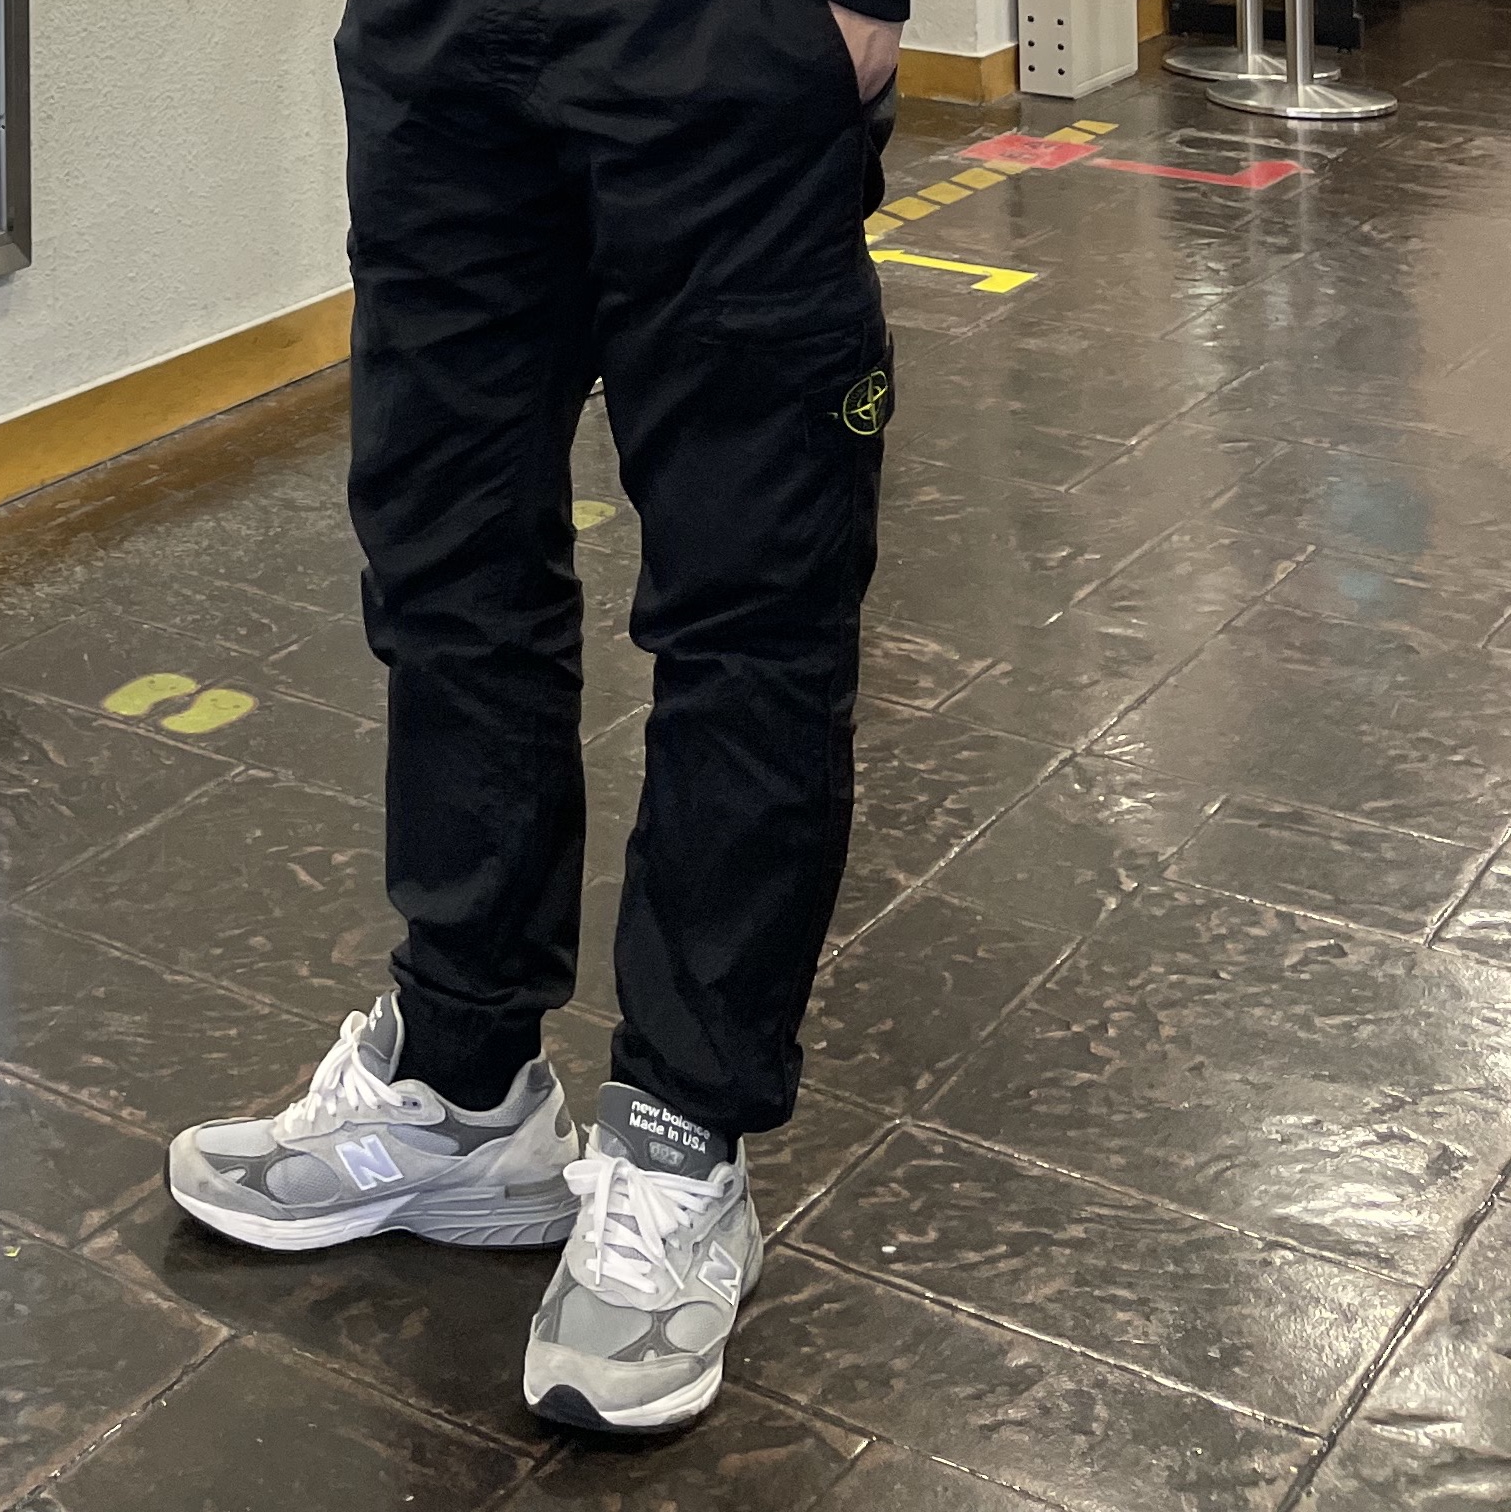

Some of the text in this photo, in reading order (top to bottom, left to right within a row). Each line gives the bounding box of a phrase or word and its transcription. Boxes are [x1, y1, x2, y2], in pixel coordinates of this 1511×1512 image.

[629, 1112, 664, 1136] Made
[682, 1131, 706, 1155] USA
[631, 1100, 711, 1140] new balance
[335, 1133, 405, 1191] N
